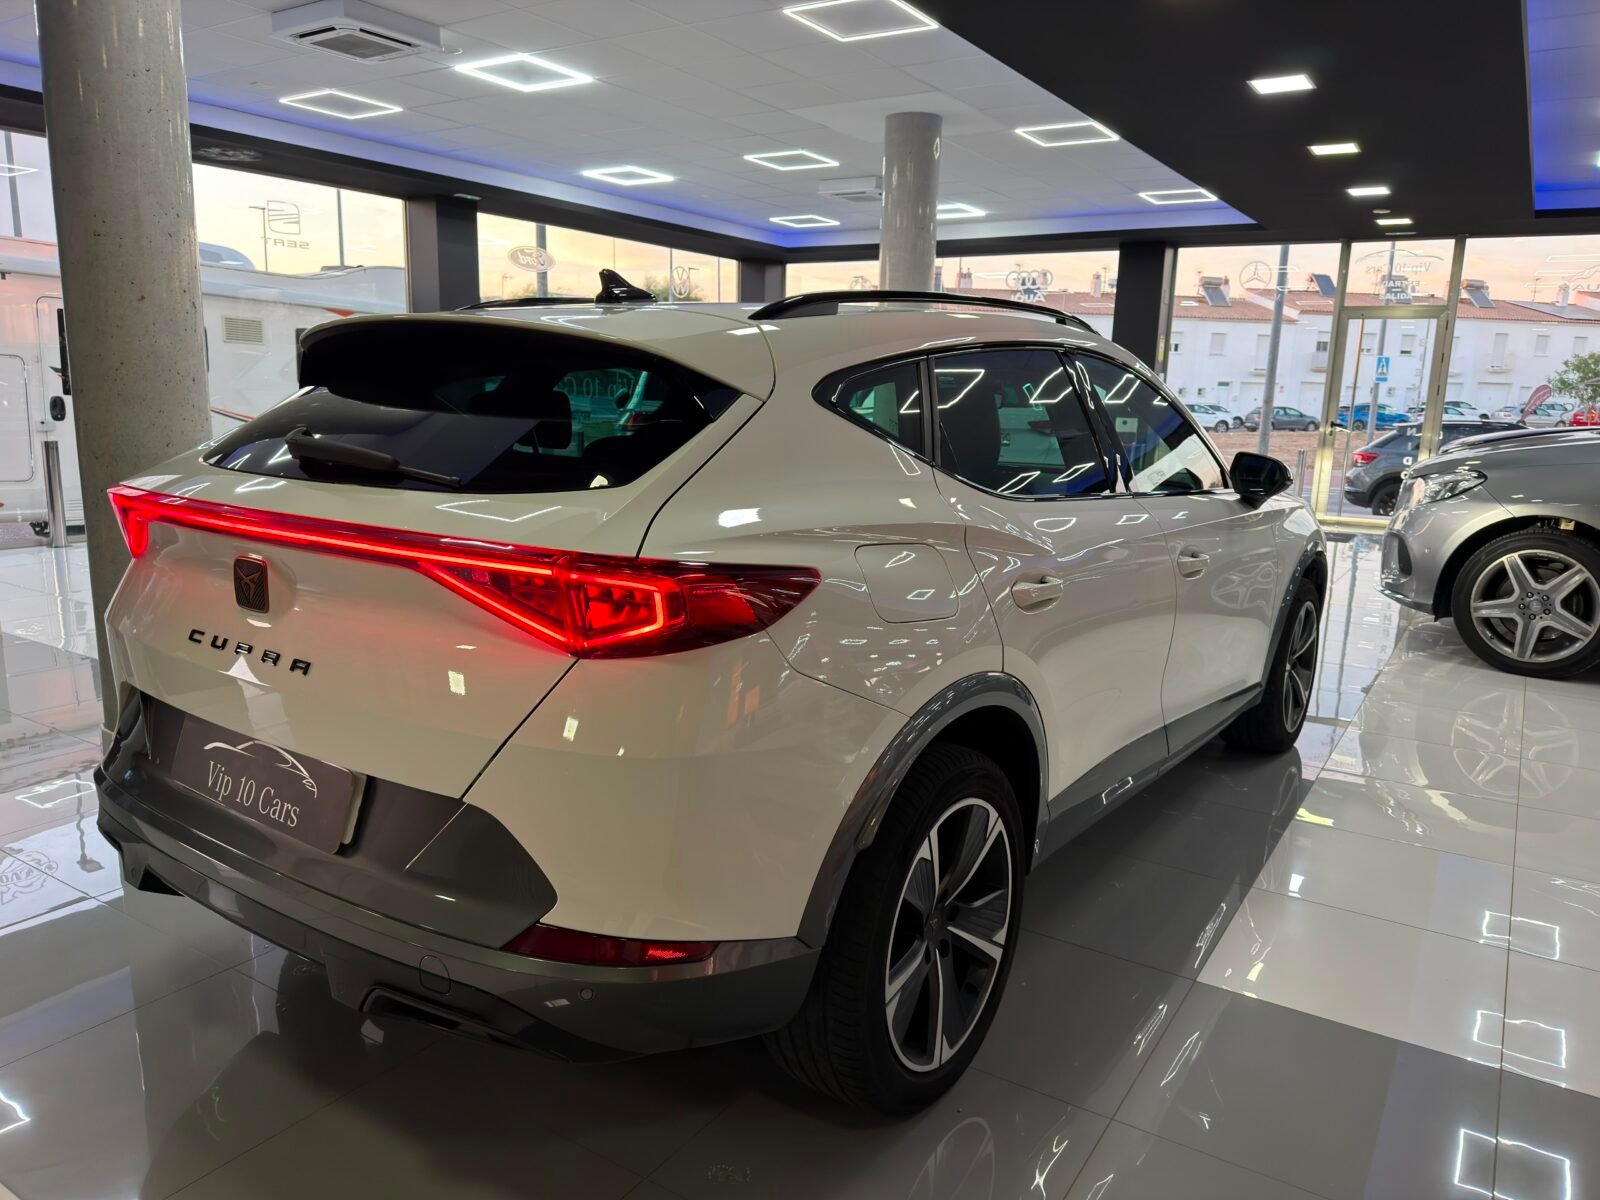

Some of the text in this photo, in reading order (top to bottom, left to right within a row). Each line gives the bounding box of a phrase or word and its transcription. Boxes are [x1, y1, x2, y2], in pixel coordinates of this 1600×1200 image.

[188, 629, 312, 676] CUPRA
[208, 760, 299, 827] Vip 10 Cars
